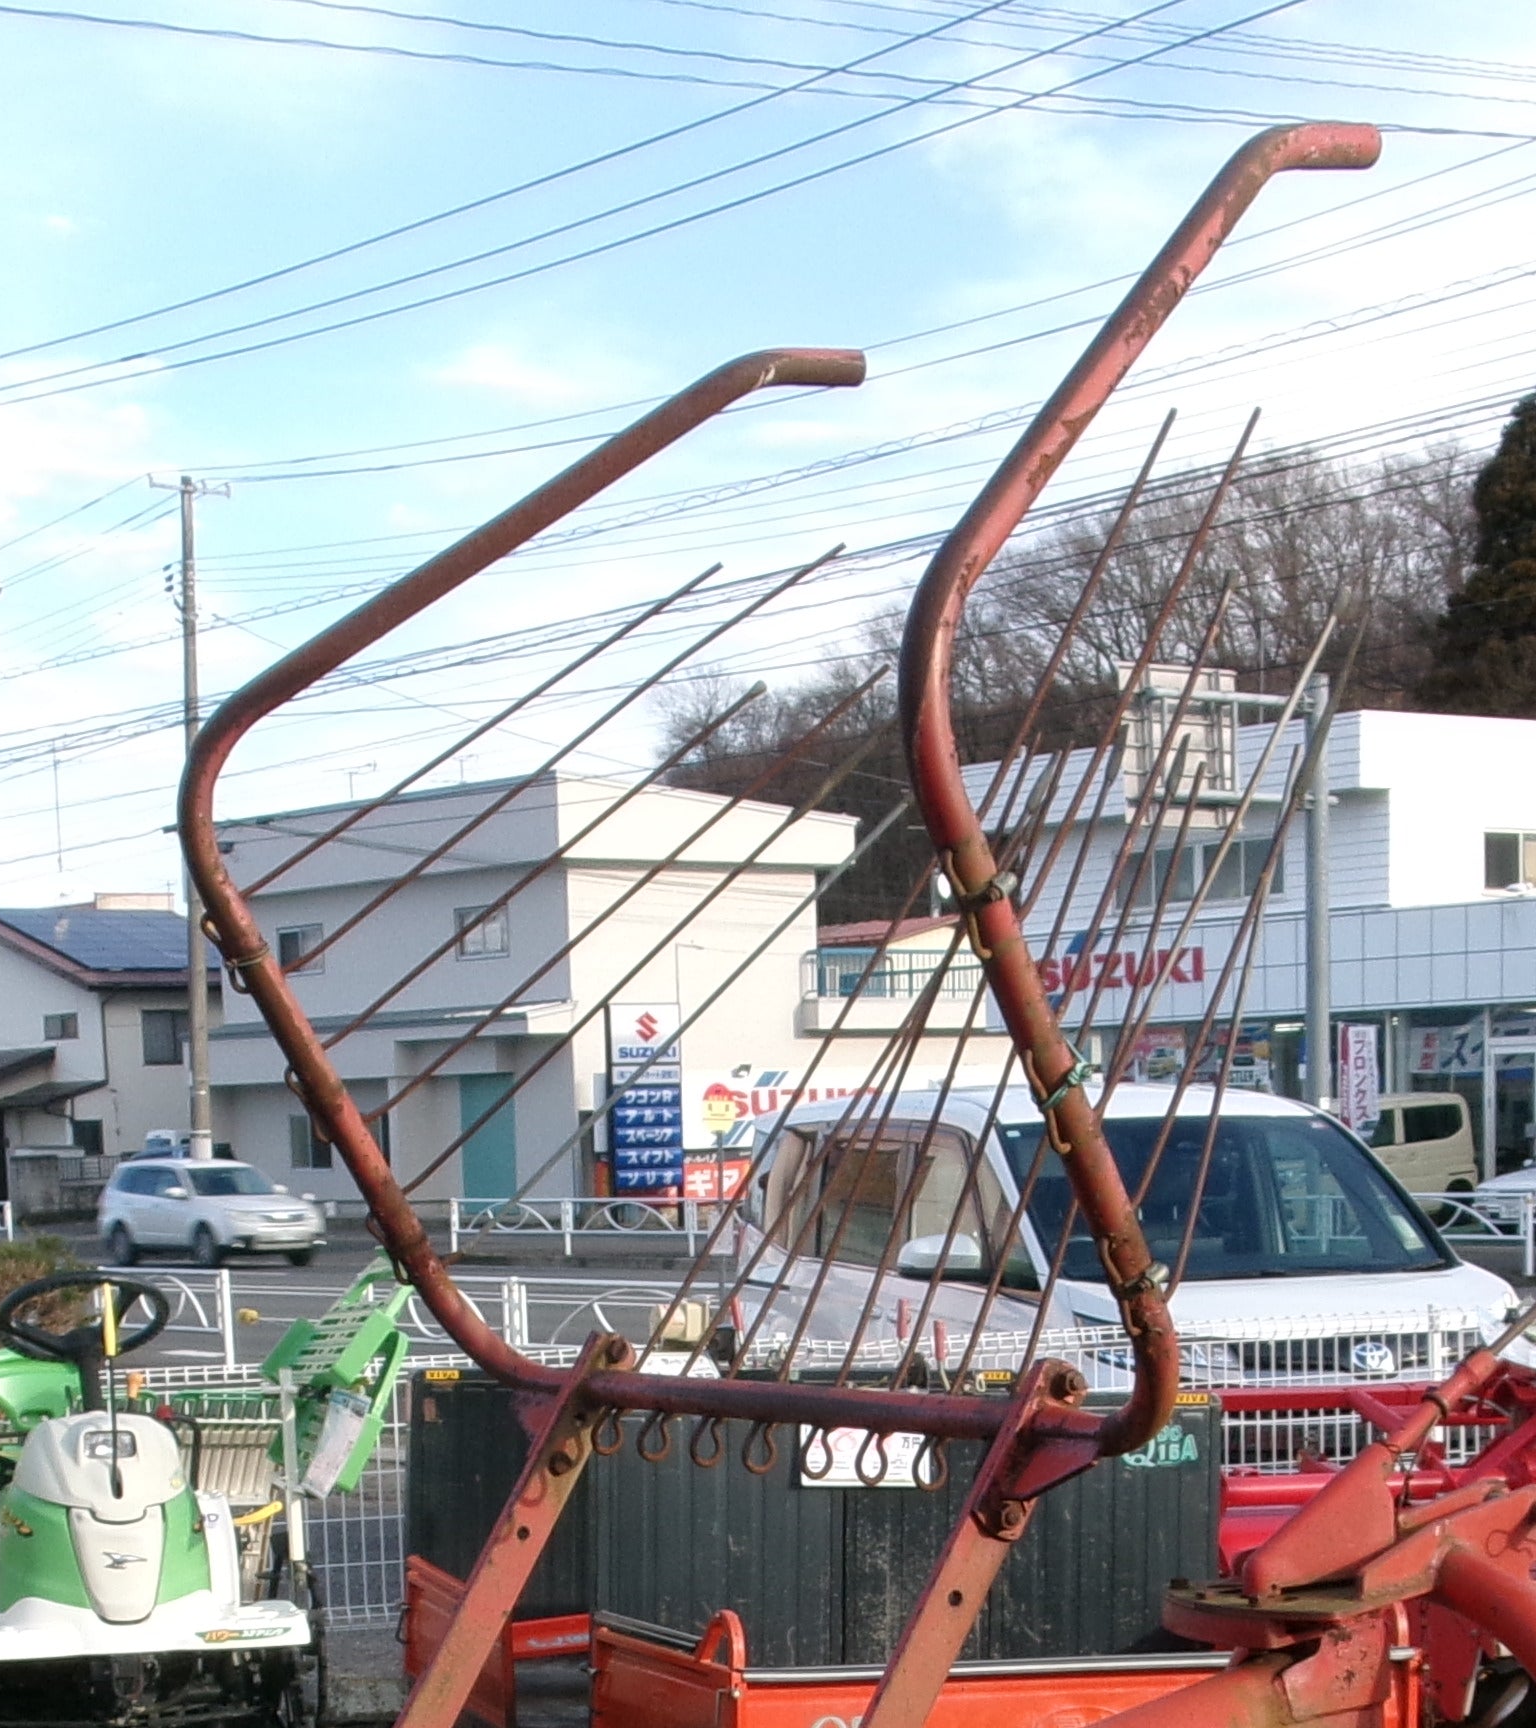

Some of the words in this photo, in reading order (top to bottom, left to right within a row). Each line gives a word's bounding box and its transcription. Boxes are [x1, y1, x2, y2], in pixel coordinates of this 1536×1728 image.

[1353, 1039, 1369, 1120] フロンクス
